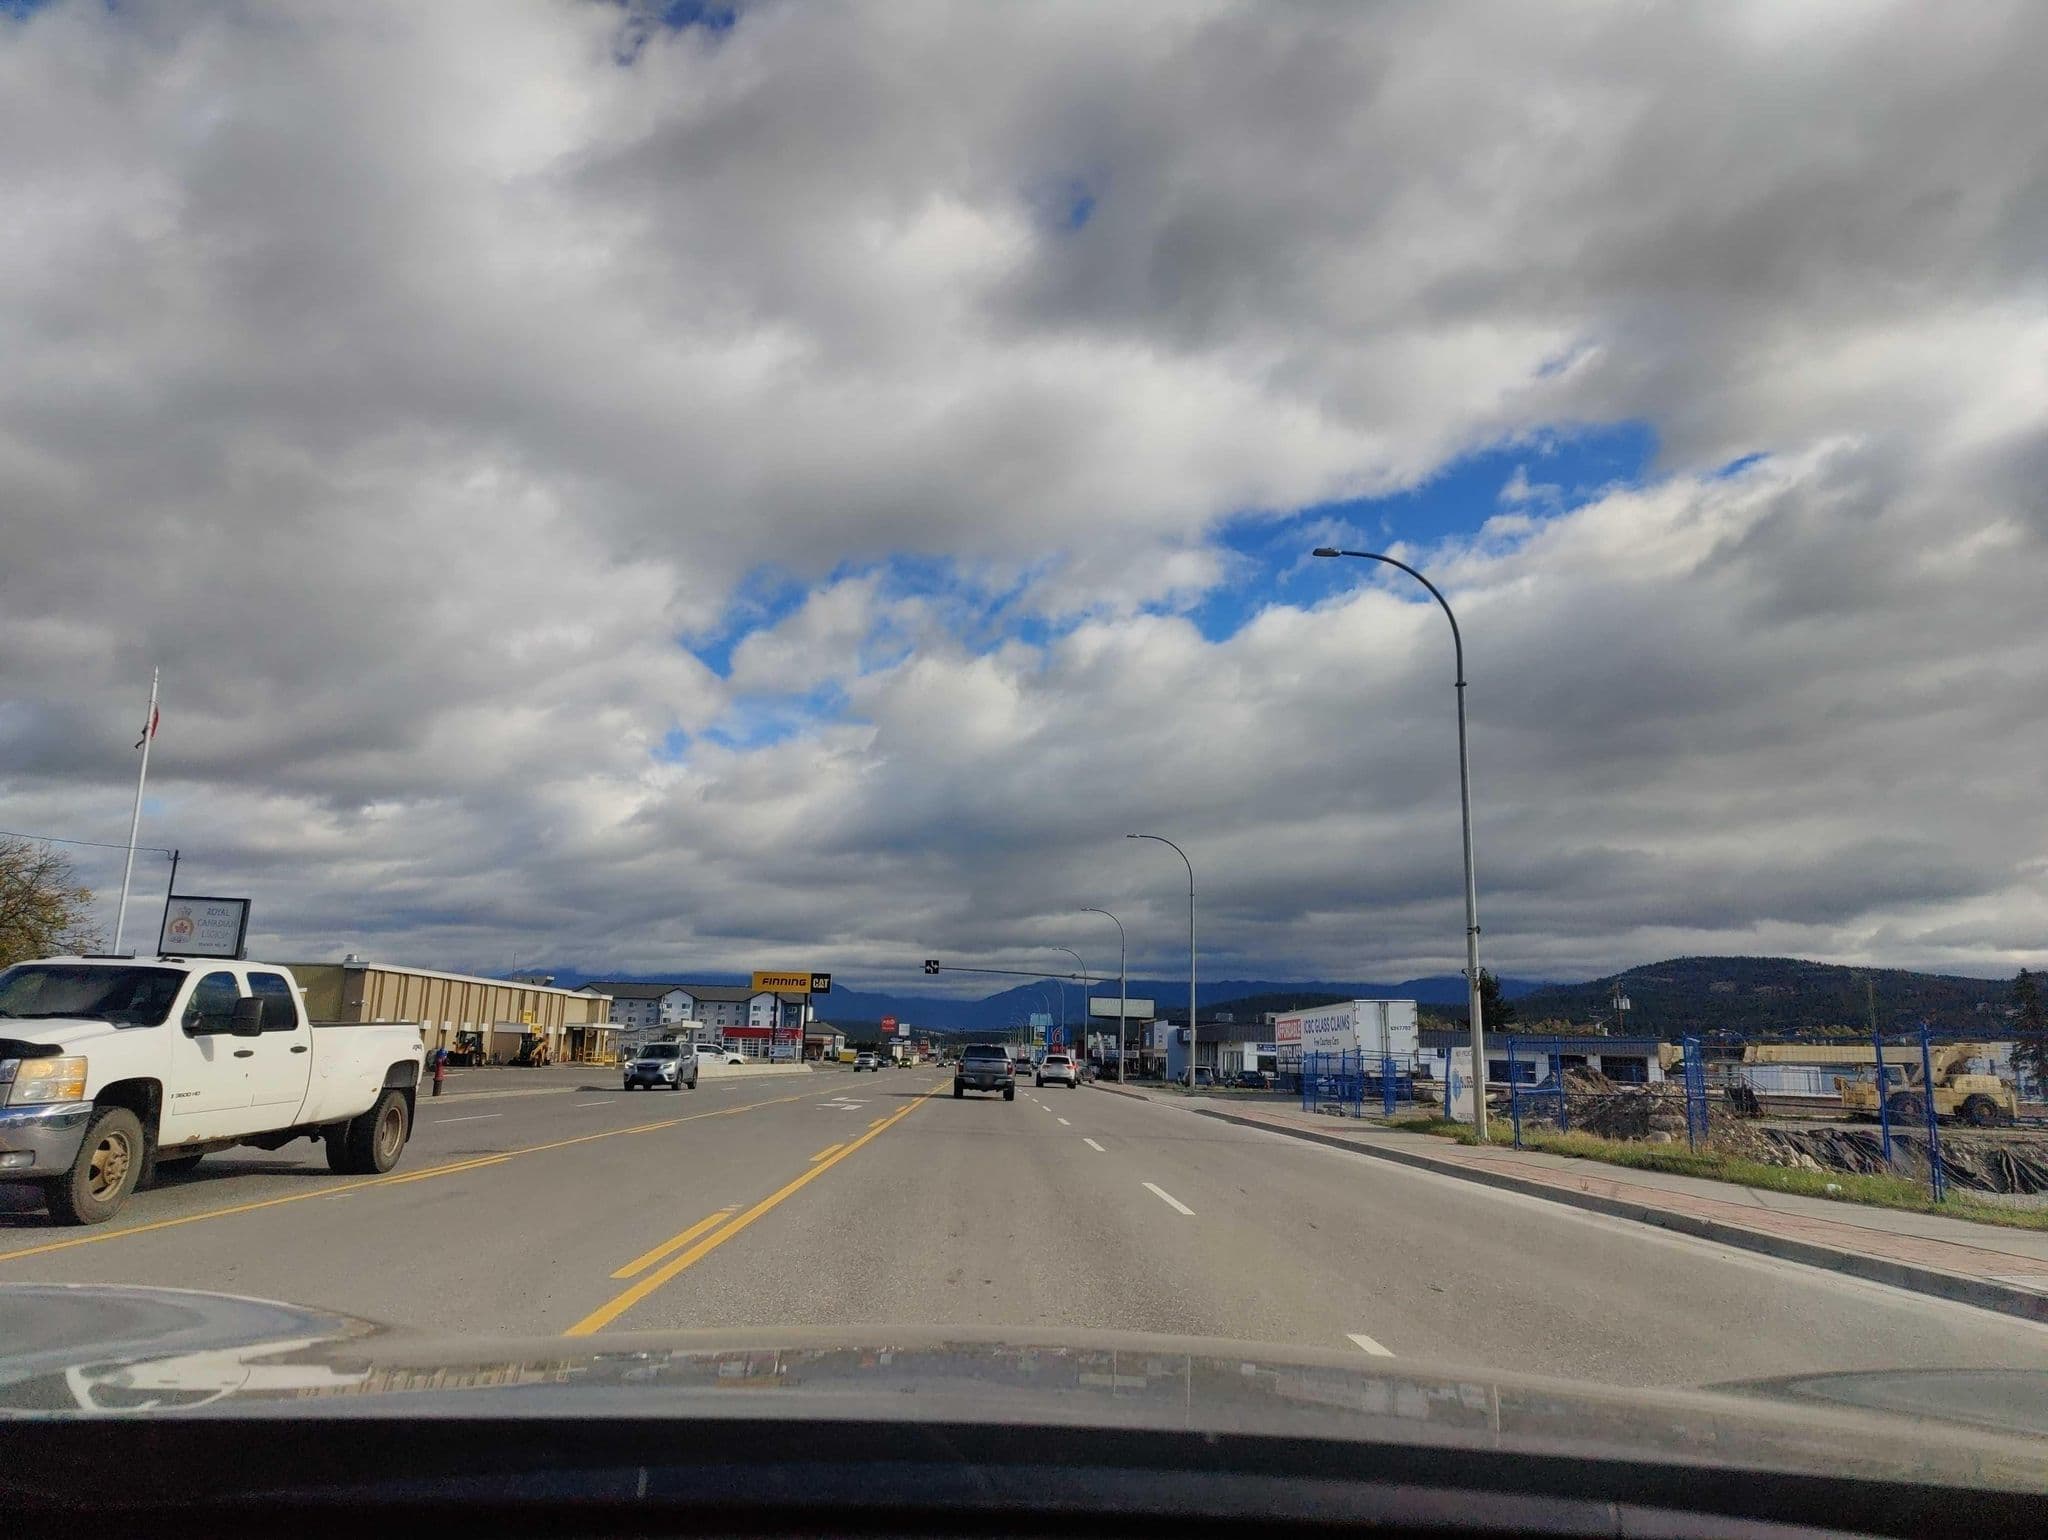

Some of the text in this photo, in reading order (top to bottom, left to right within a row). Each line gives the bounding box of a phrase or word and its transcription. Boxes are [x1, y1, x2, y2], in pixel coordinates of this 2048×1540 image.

[762, 977, 830, 989] FINNING CAT
[1315, 1016, 1330, 1033] GLASS
[1330, 1013, 1350, 1032] CLAIMS
